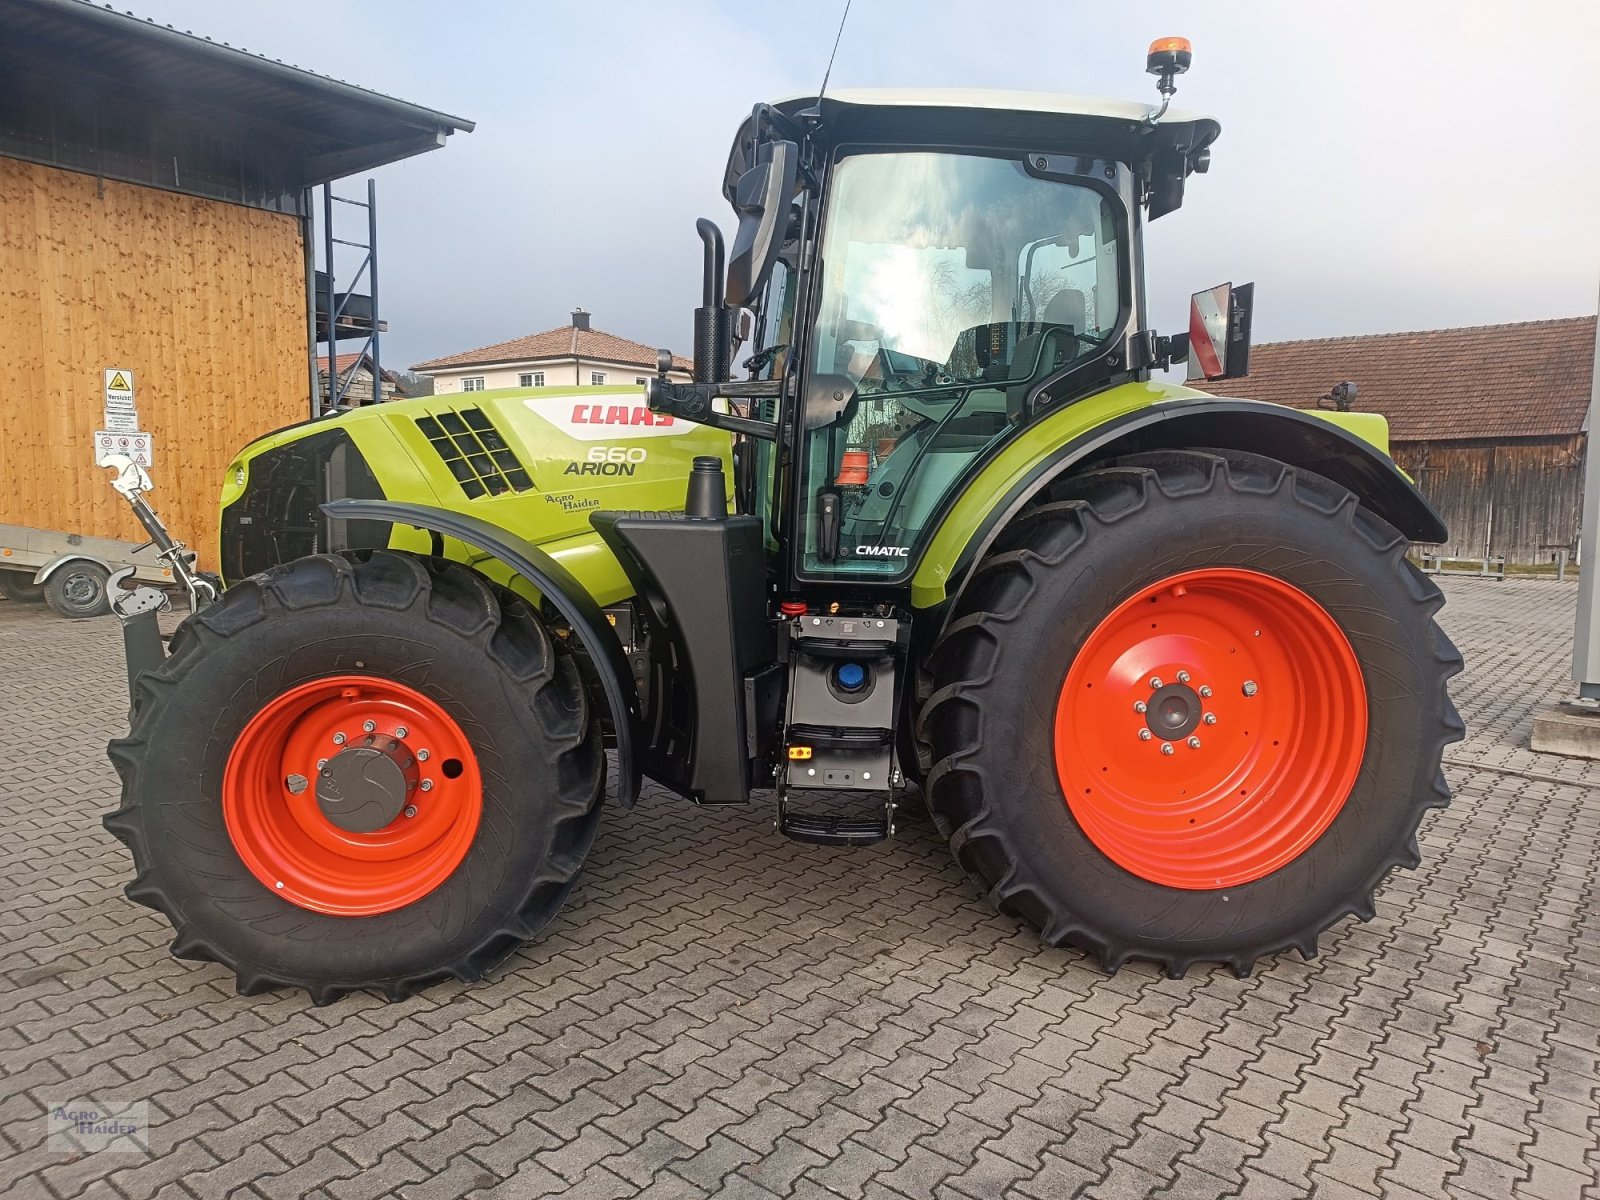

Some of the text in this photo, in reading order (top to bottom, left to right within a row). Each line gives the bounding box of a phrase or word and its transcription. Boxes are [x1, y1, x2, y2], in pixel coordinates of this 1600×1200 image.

[571, 405, 674, 426] CLAAS
[587, 446, 647, 463] 660
[563, 462, 636, 476] ARION
[855, 545, 910, 557] CMATIC
